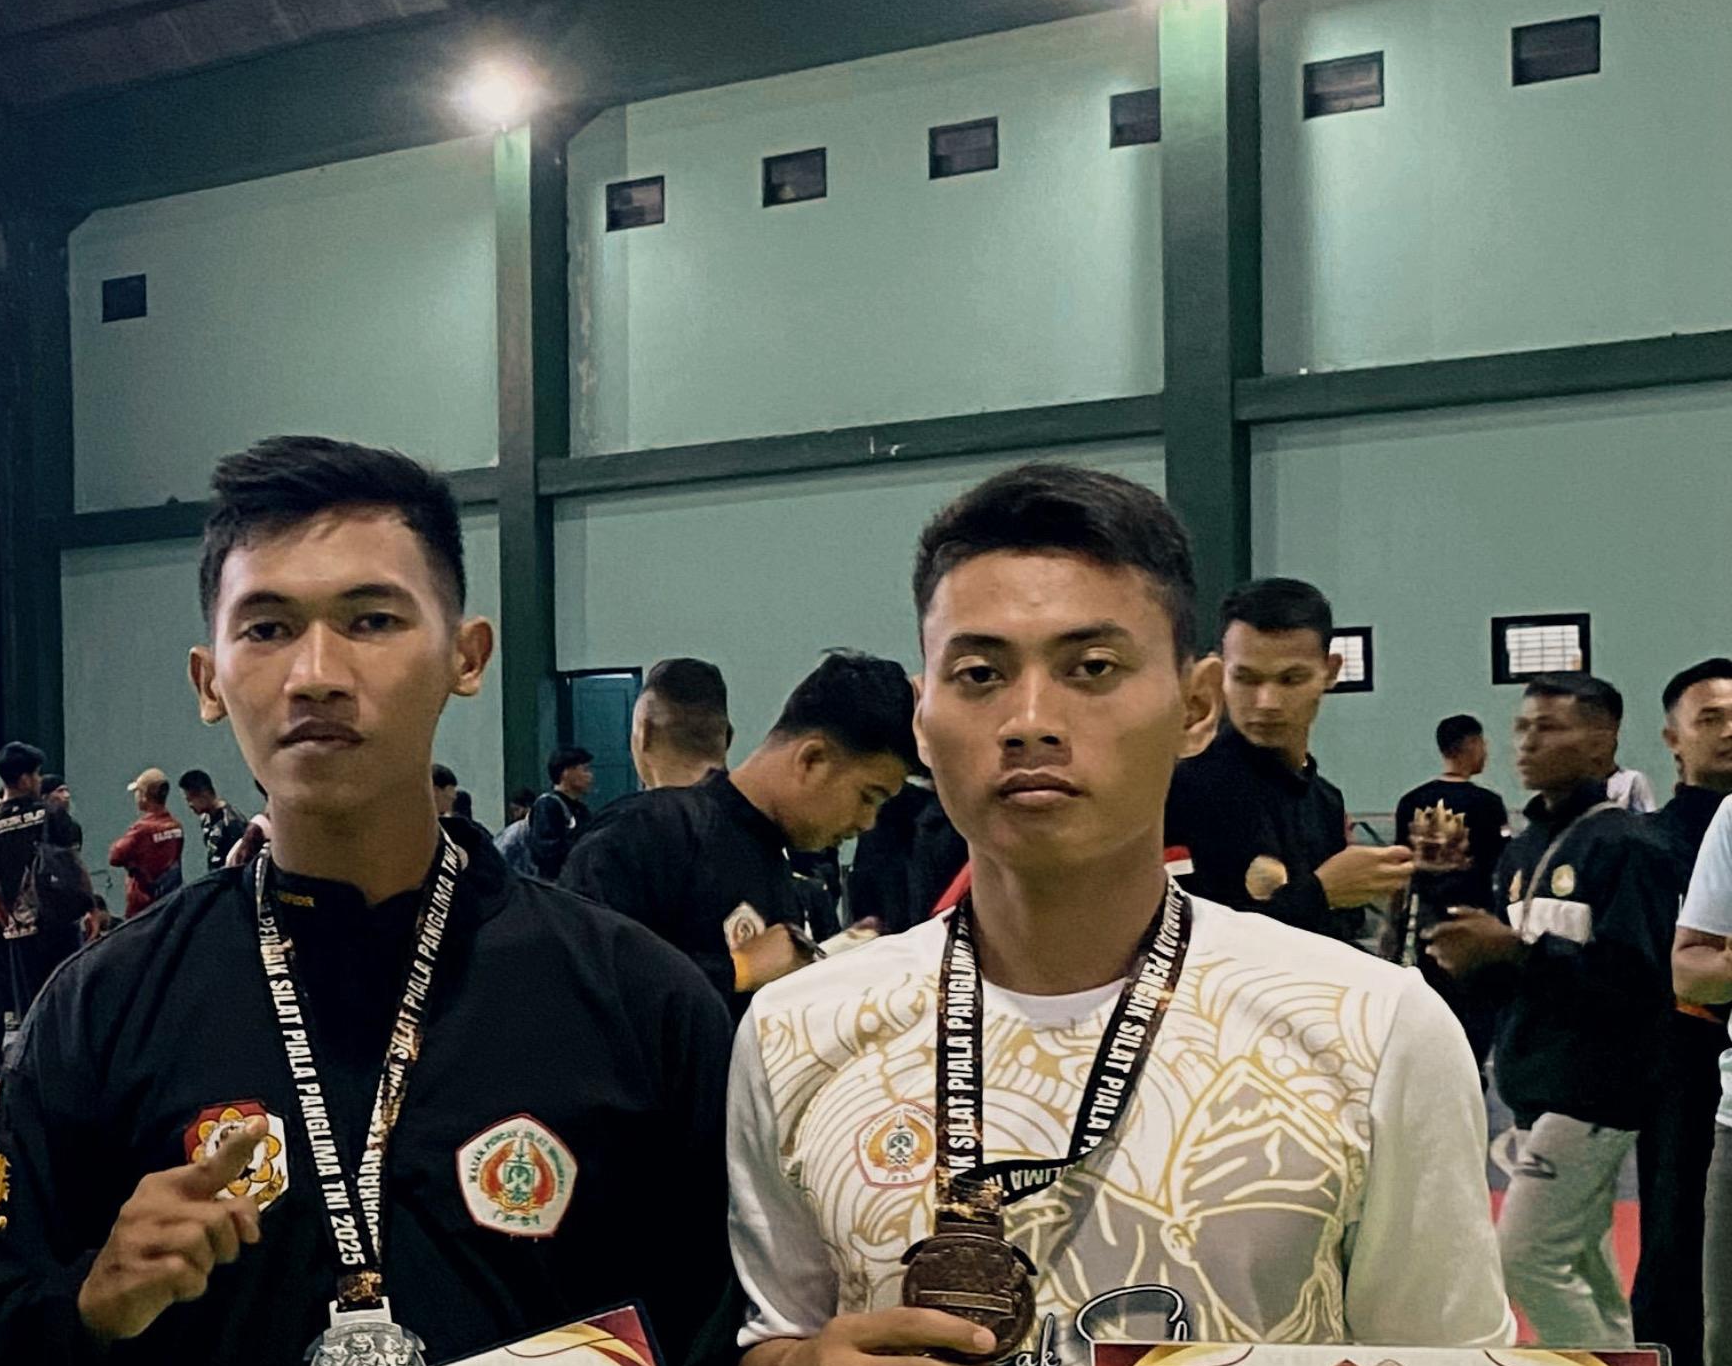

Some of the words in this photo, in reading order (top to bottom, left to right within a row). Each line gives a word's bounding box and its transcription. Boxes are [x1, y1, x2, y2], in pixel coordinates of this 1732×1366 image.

[415, 874, 456, 960] PANGLIMA
[269, 976, 301, 1029] SILAT
[400, 959, 434, 1009] PIALA
[1122, 951, 1174, 1025] PENCAK
[282, 1027, 315, 1081] PIALA
[947, 1035, 975, 1090] PIALA
[1103, 1018, 1147, 1075] SILAT
[296, 1080, 340, 1177] PANGLIMA
[949, 1095, 976, 1149] SILAT
[1084, 1073, 1126, 1131] PIALA
[321, 1178, 350, 1212] TNI
[329, 1210, 364, 1267] 2025
